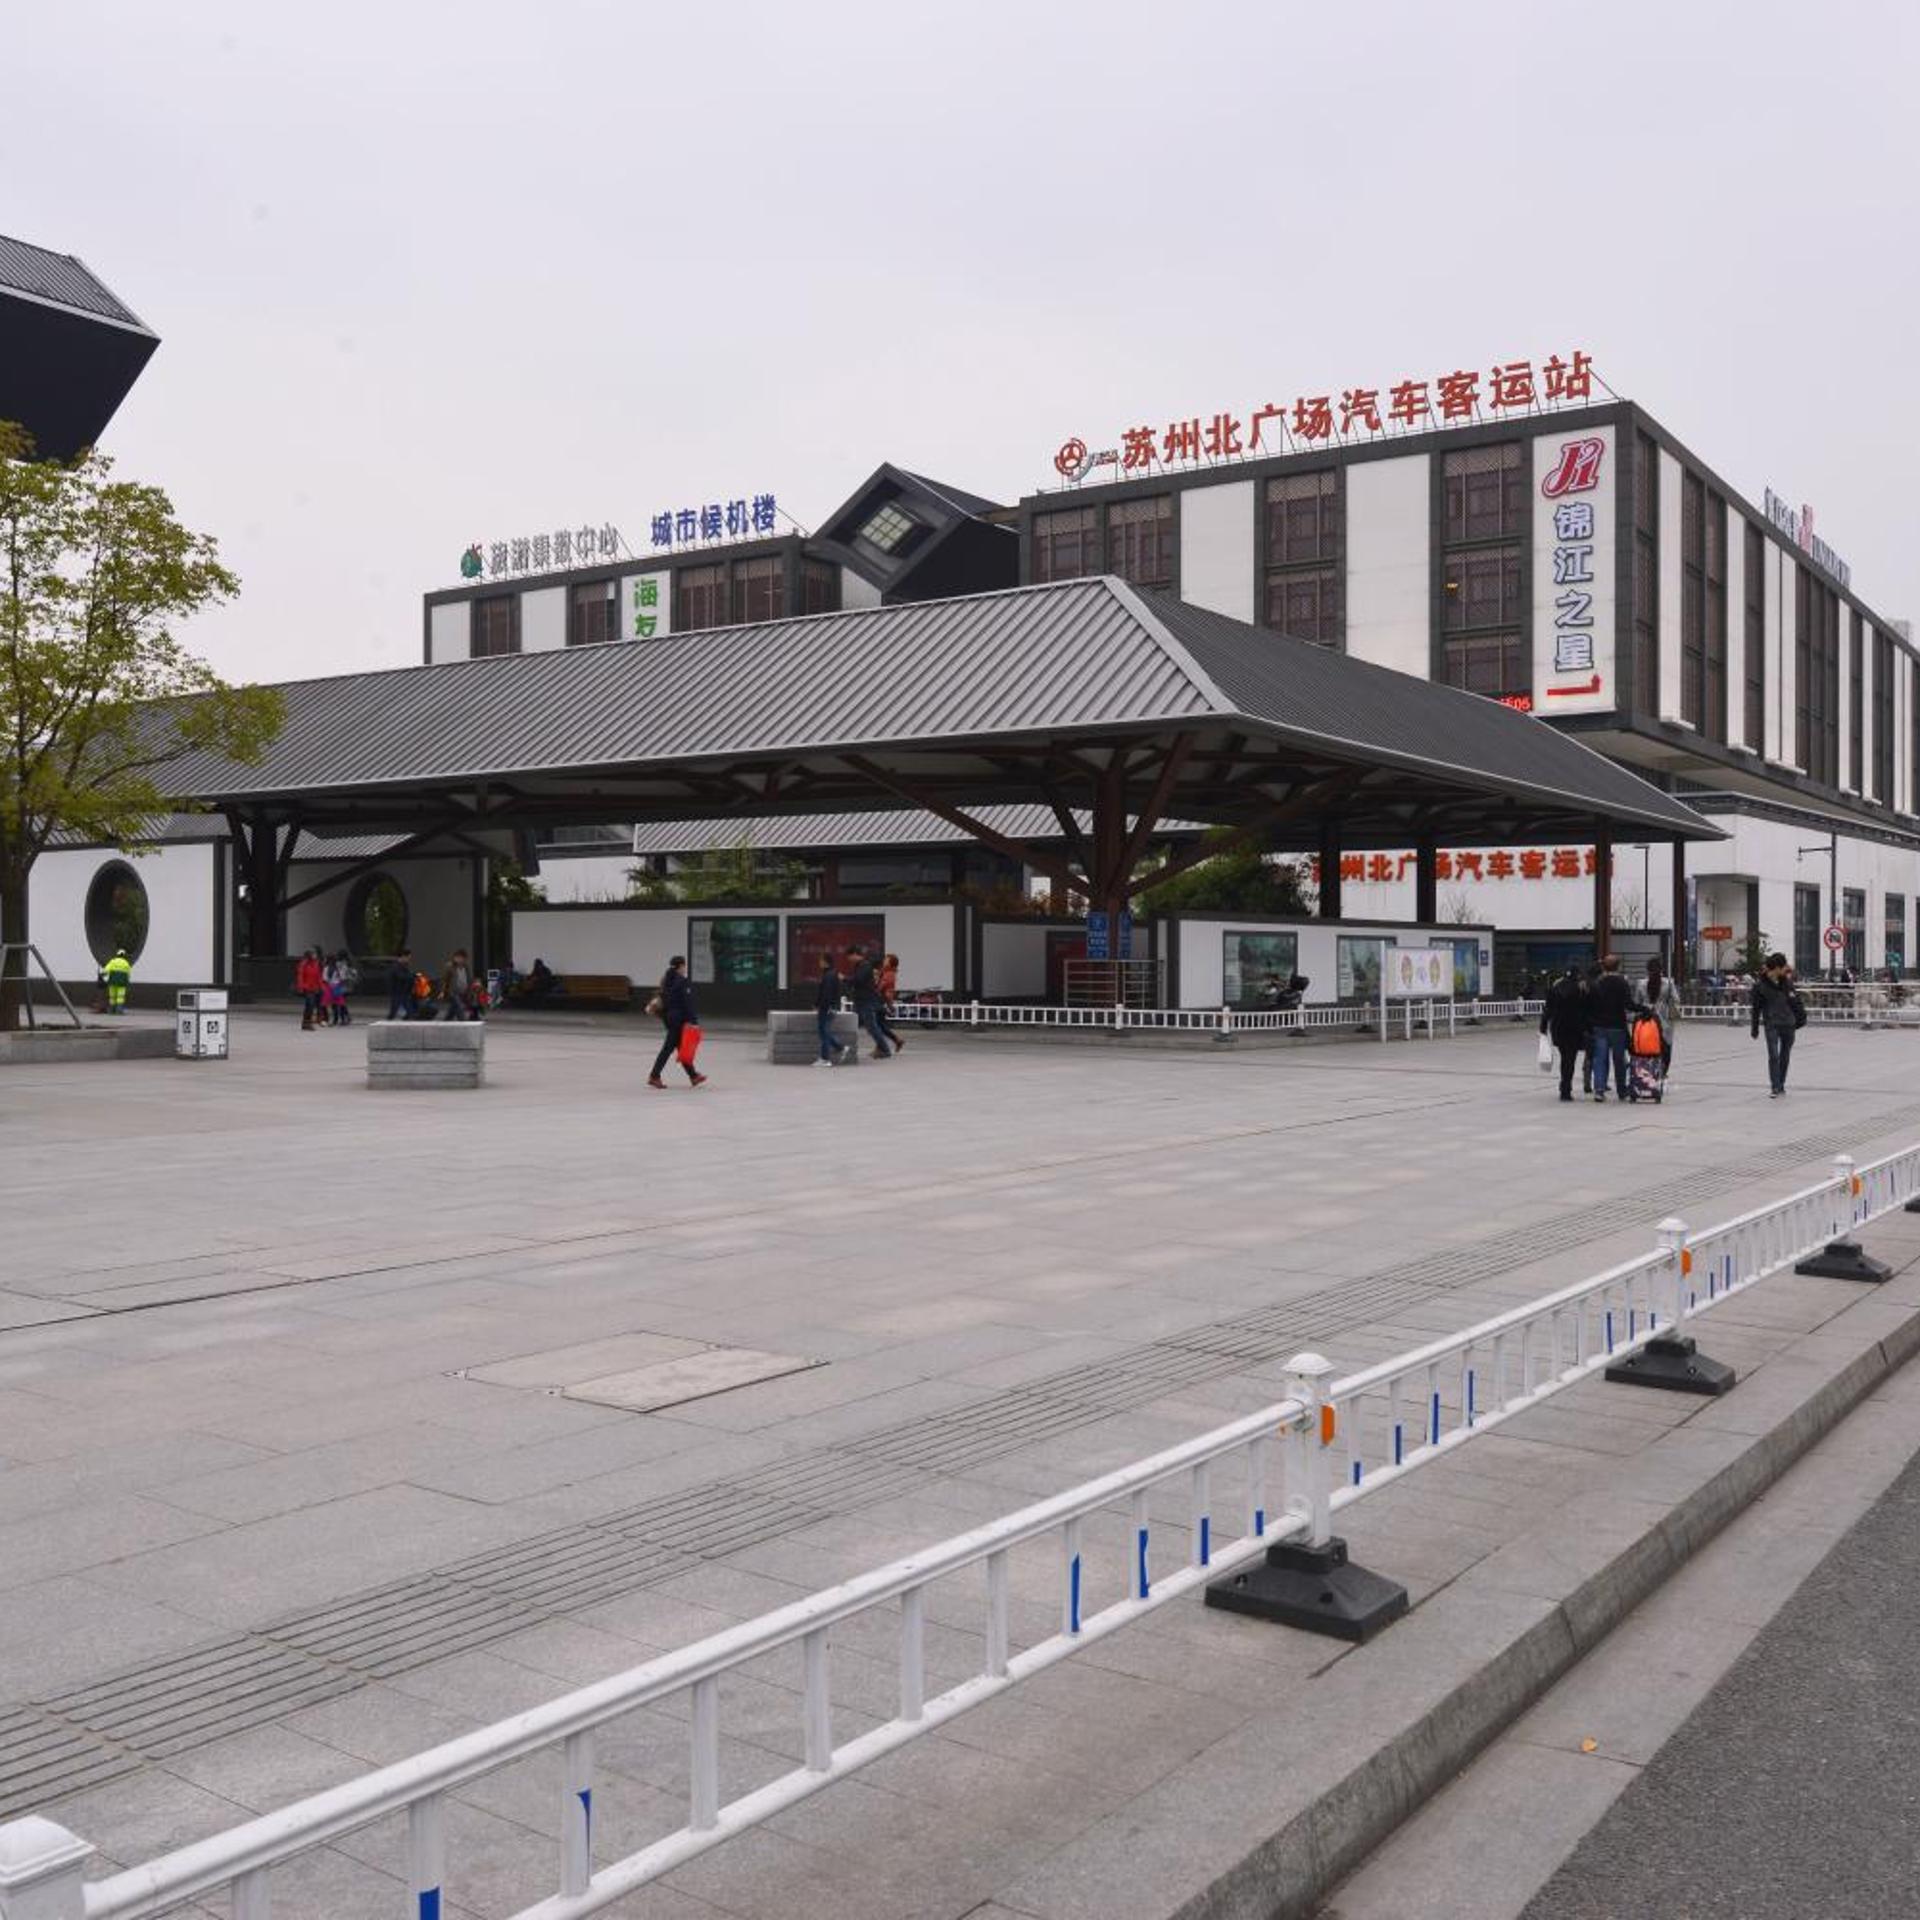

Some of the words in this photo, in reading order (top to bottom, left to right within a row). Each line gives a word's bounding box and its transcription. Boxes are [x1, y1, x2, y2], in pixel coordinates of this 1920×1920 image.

[1121, 351, 1593, 470] 苏州北广场汽车客运站
[650, 493, 776, 546] 城市候机楼
[1552, 501, 1595, 673] 锦江之星
